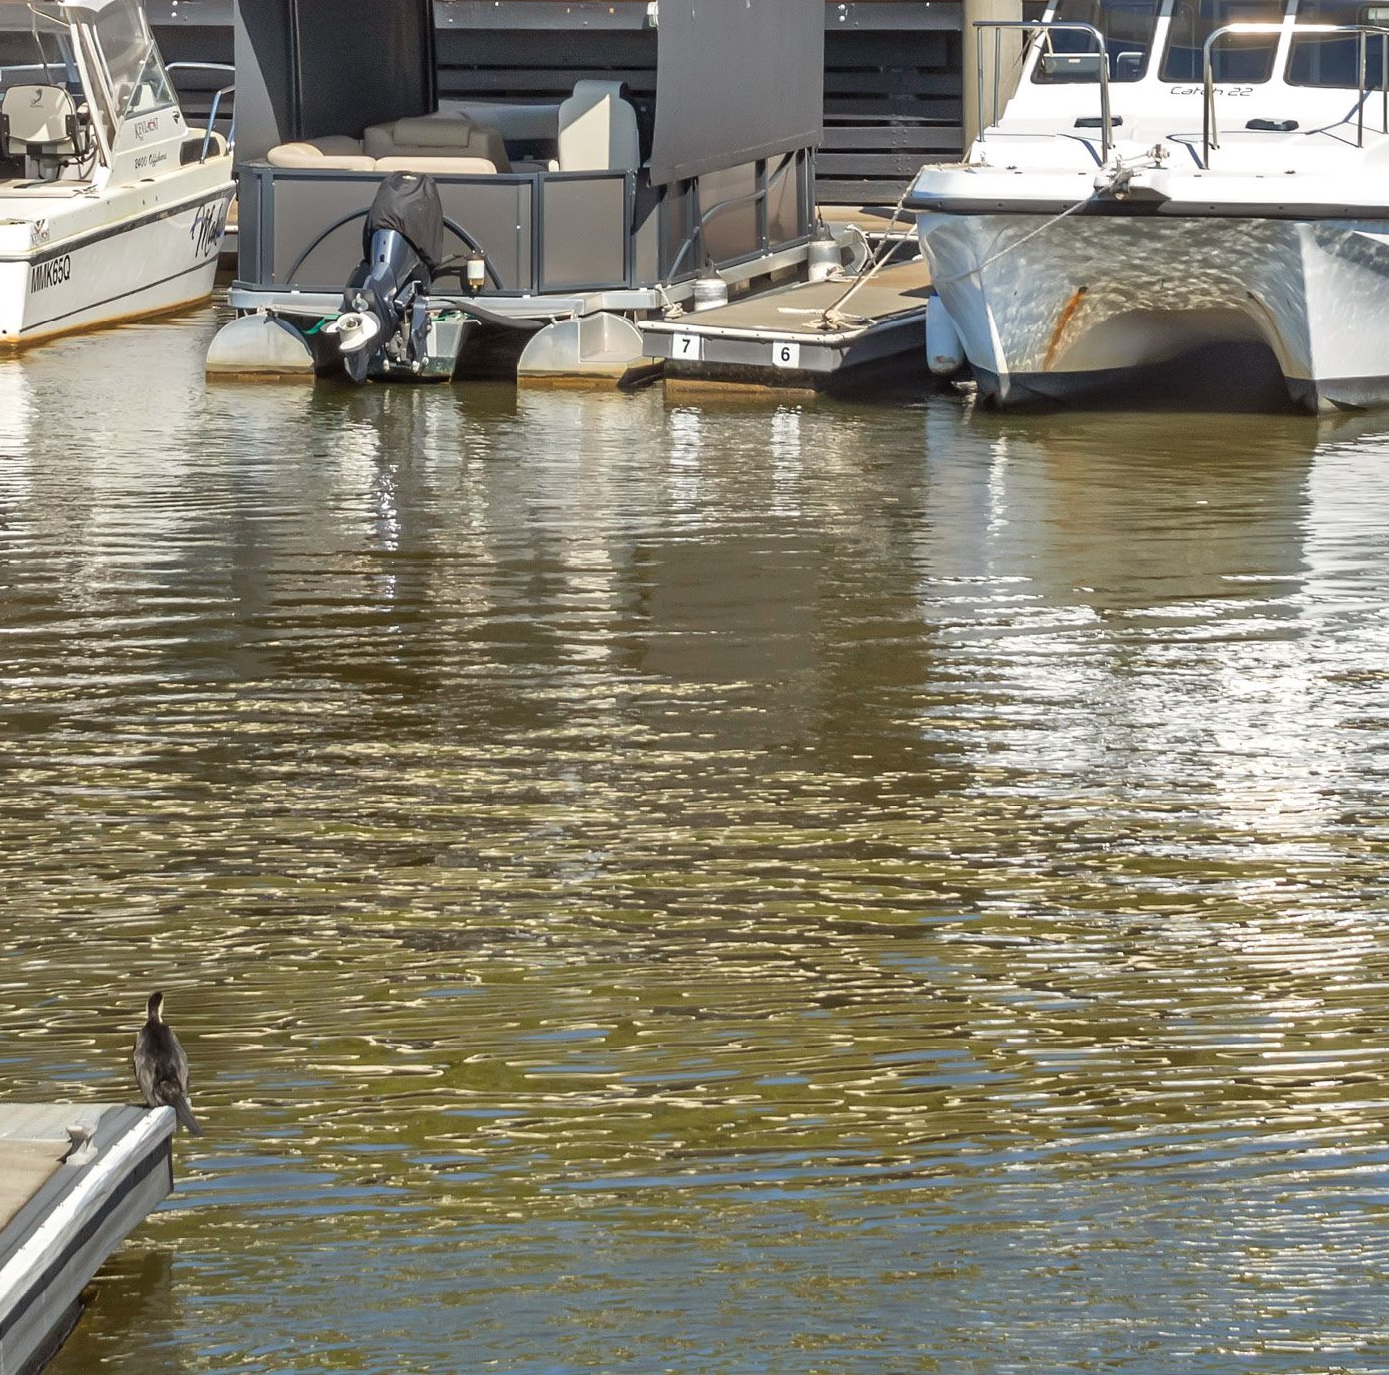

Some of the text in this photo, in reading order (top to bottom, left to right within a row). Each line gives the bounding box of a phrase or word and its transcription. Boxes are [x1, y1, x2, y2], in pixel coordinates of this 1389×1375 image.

[1227, 87, 1253, 97] 22
[31, 254, 71, 294] MMK65Q
[682, 338, 691, 353] 7
[781, 346, 791, 362] 6
